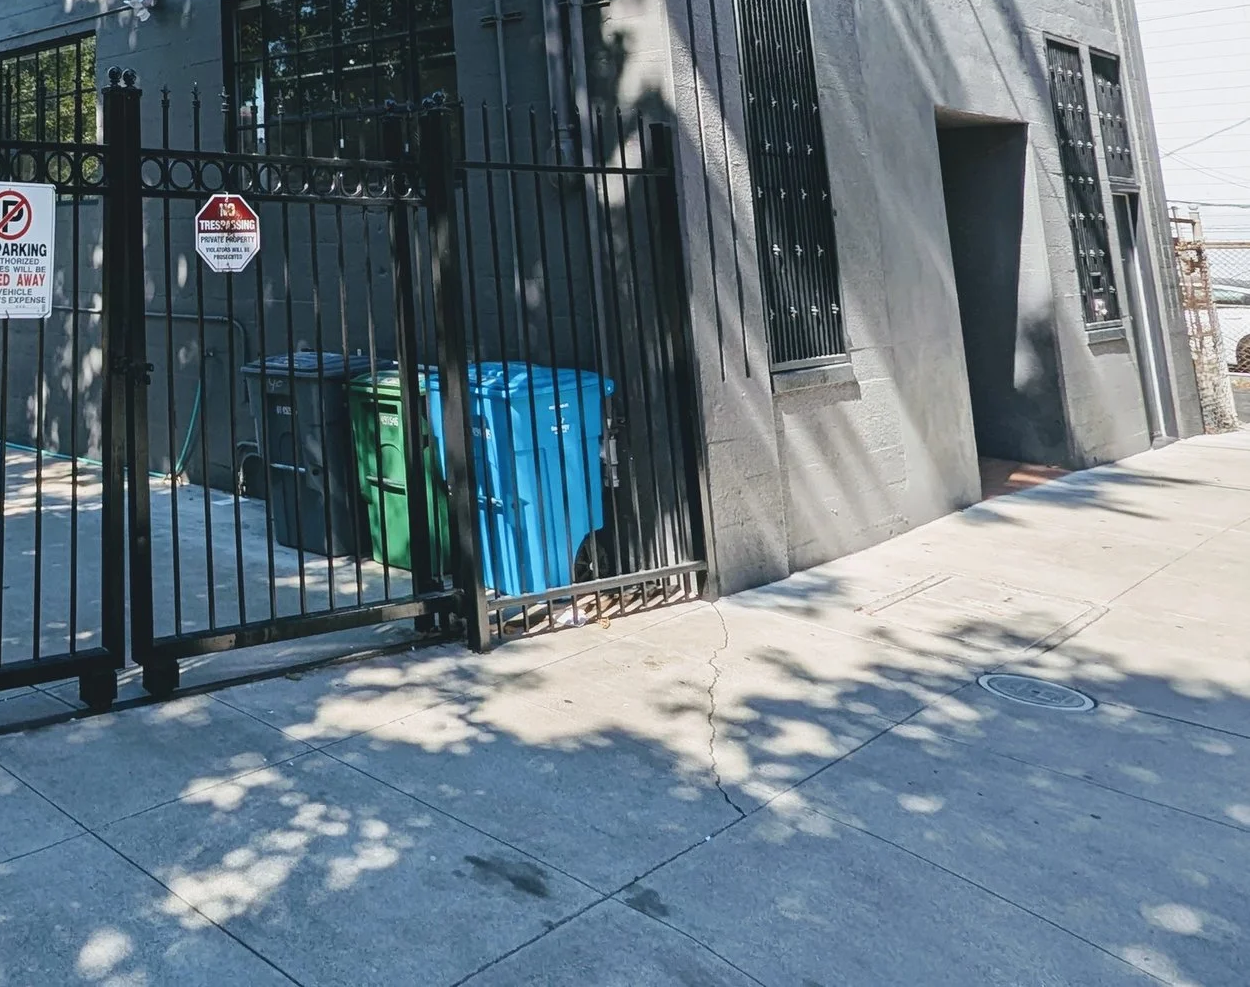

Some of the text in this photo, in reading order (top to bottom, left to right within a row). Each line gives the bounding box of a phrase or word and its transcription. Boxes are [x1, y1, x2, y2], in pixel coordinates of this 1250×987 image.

[219, 203, 236, 217] NO
[199, 219, 255, 230] TRESPASSING
[225, 236, 254, 244] PROPERTY
[13, 265, 32, 273] WILL
[16, 274, 46, 287] AWAY
[8, 296, 46, 304] EXPENSE
